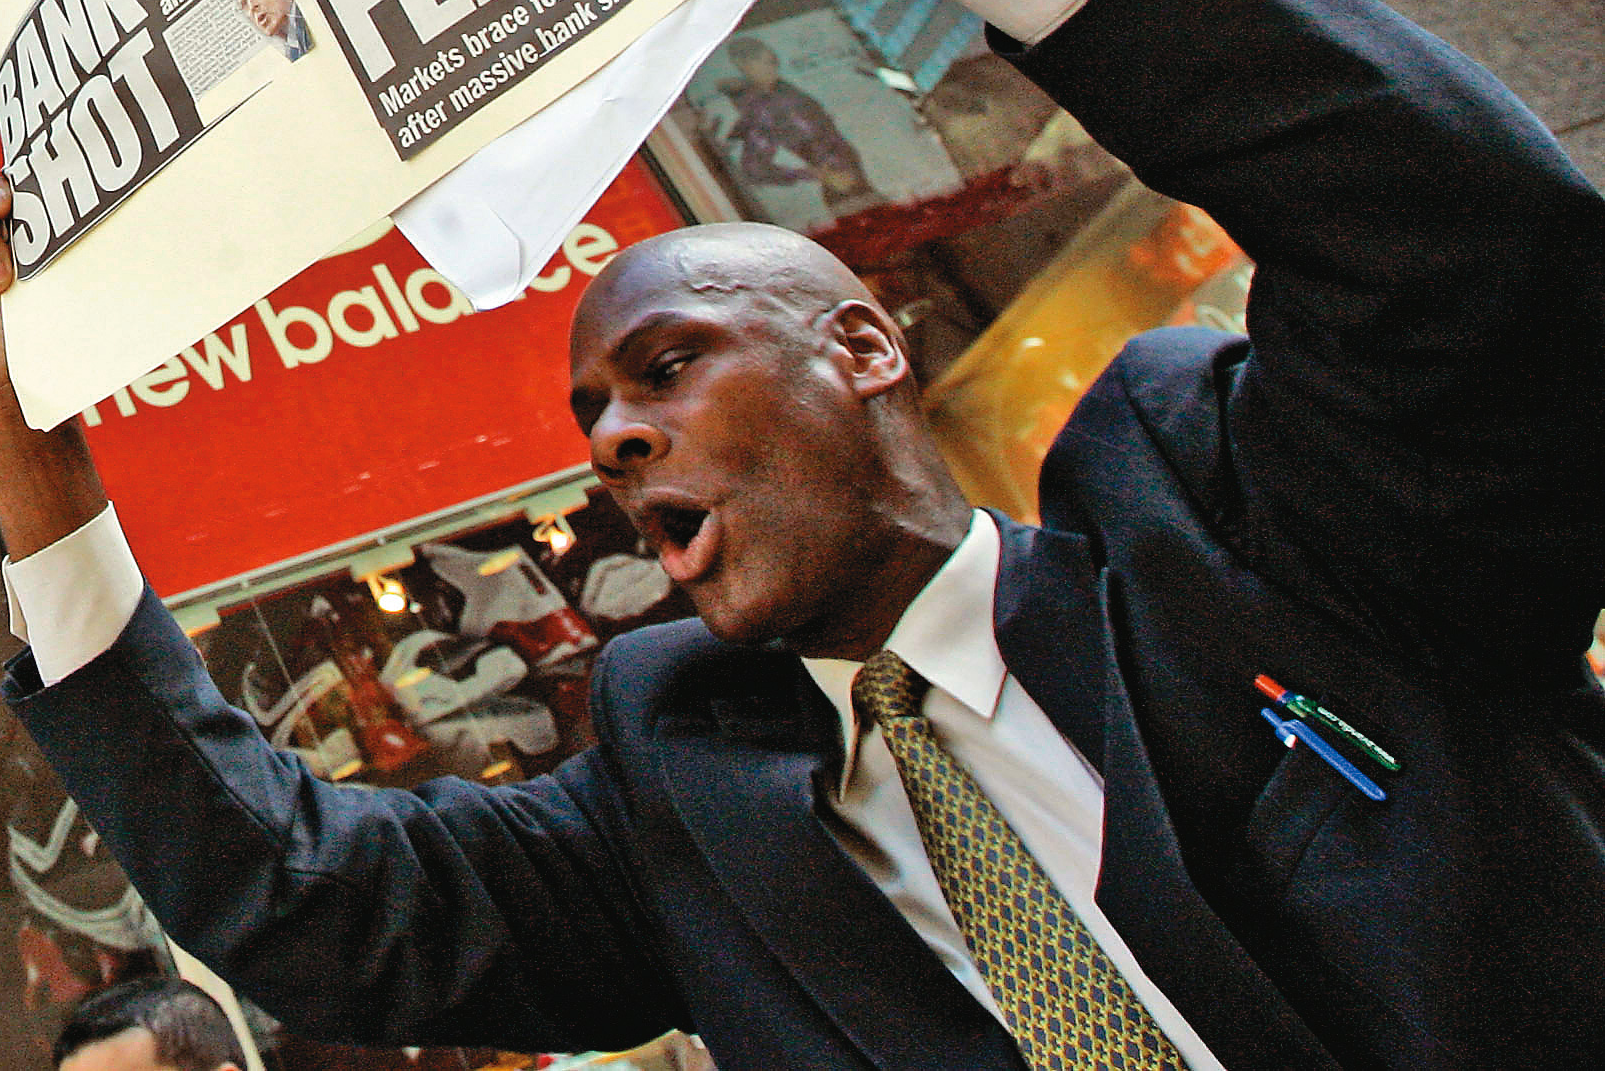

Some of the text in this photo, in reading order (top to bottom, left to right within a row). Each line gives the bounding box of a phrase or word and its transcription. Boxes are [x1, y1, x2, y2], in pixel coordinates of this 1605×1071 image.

[378, 46, 466, 118] Markets
[461, 3, 531, 58] brace
[397, 99, 449, 149] after
[448, 43, 540, 113] massive
[534, 0, 598, 53] bank
[11, 26, 181, 267] SHOT
[255, 222, 620, 369] balae
